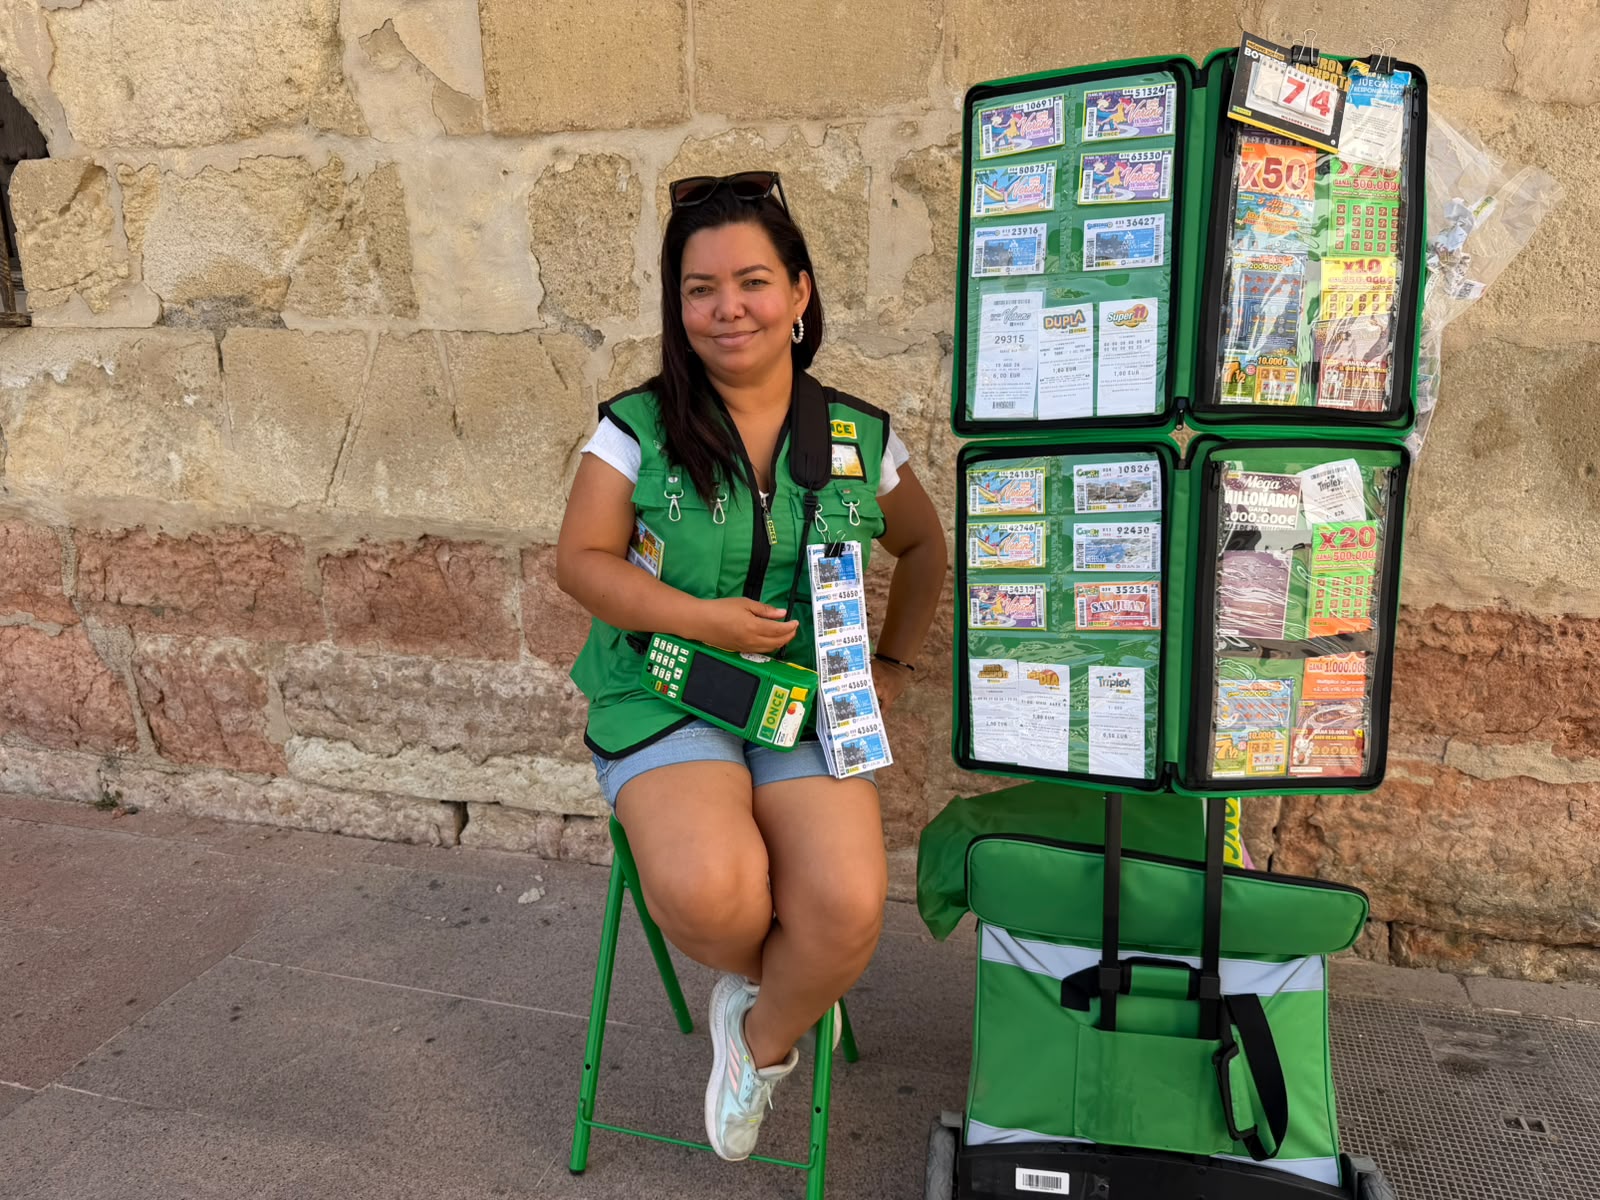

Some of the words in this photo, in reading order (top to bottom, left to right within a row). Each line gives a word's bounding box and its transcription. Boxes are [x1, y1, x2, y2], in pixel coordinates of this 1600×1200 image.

[1135, 86, 1164, 97] 51324
[1026, 99, 1052, 110] 10691
[1131, 152, 1160, 161] 63530
[1352, 178, 1400, 192] 500.000
[1126, 217, 1155, 227] 36427
[1011, 227, 1038, 235] 23916
[1044, 309, 1086, 330] DUPLA
[1107, 312, 1134, 323] Super
[994, 335, 1025, 345] 29315
[1009, 470, 1034, 478] 24183
[1118, 464, 1150, 474] 10826
[1244, 475, 1281, 491] Mega
[1225, 511, 1296, 526] .000.000€
[1117, 526, 1150, 534] 92430
[1318, 525, 1377, 551] x20
[1333, 550, 1377, 562] 500.000
[839, 590, 859, 599] 43650
[1091, 600, 1114, 613] SAN
[1113, 600, 1146, 613] JUAN
[843, 635, 863, 644] 43650
[848, 680, 868, 690] 43650
[1096, 673, 1131, 688] Triplex
[767, 690, 785, 725] ONCE
[857, 723, 878, 735] 43650
